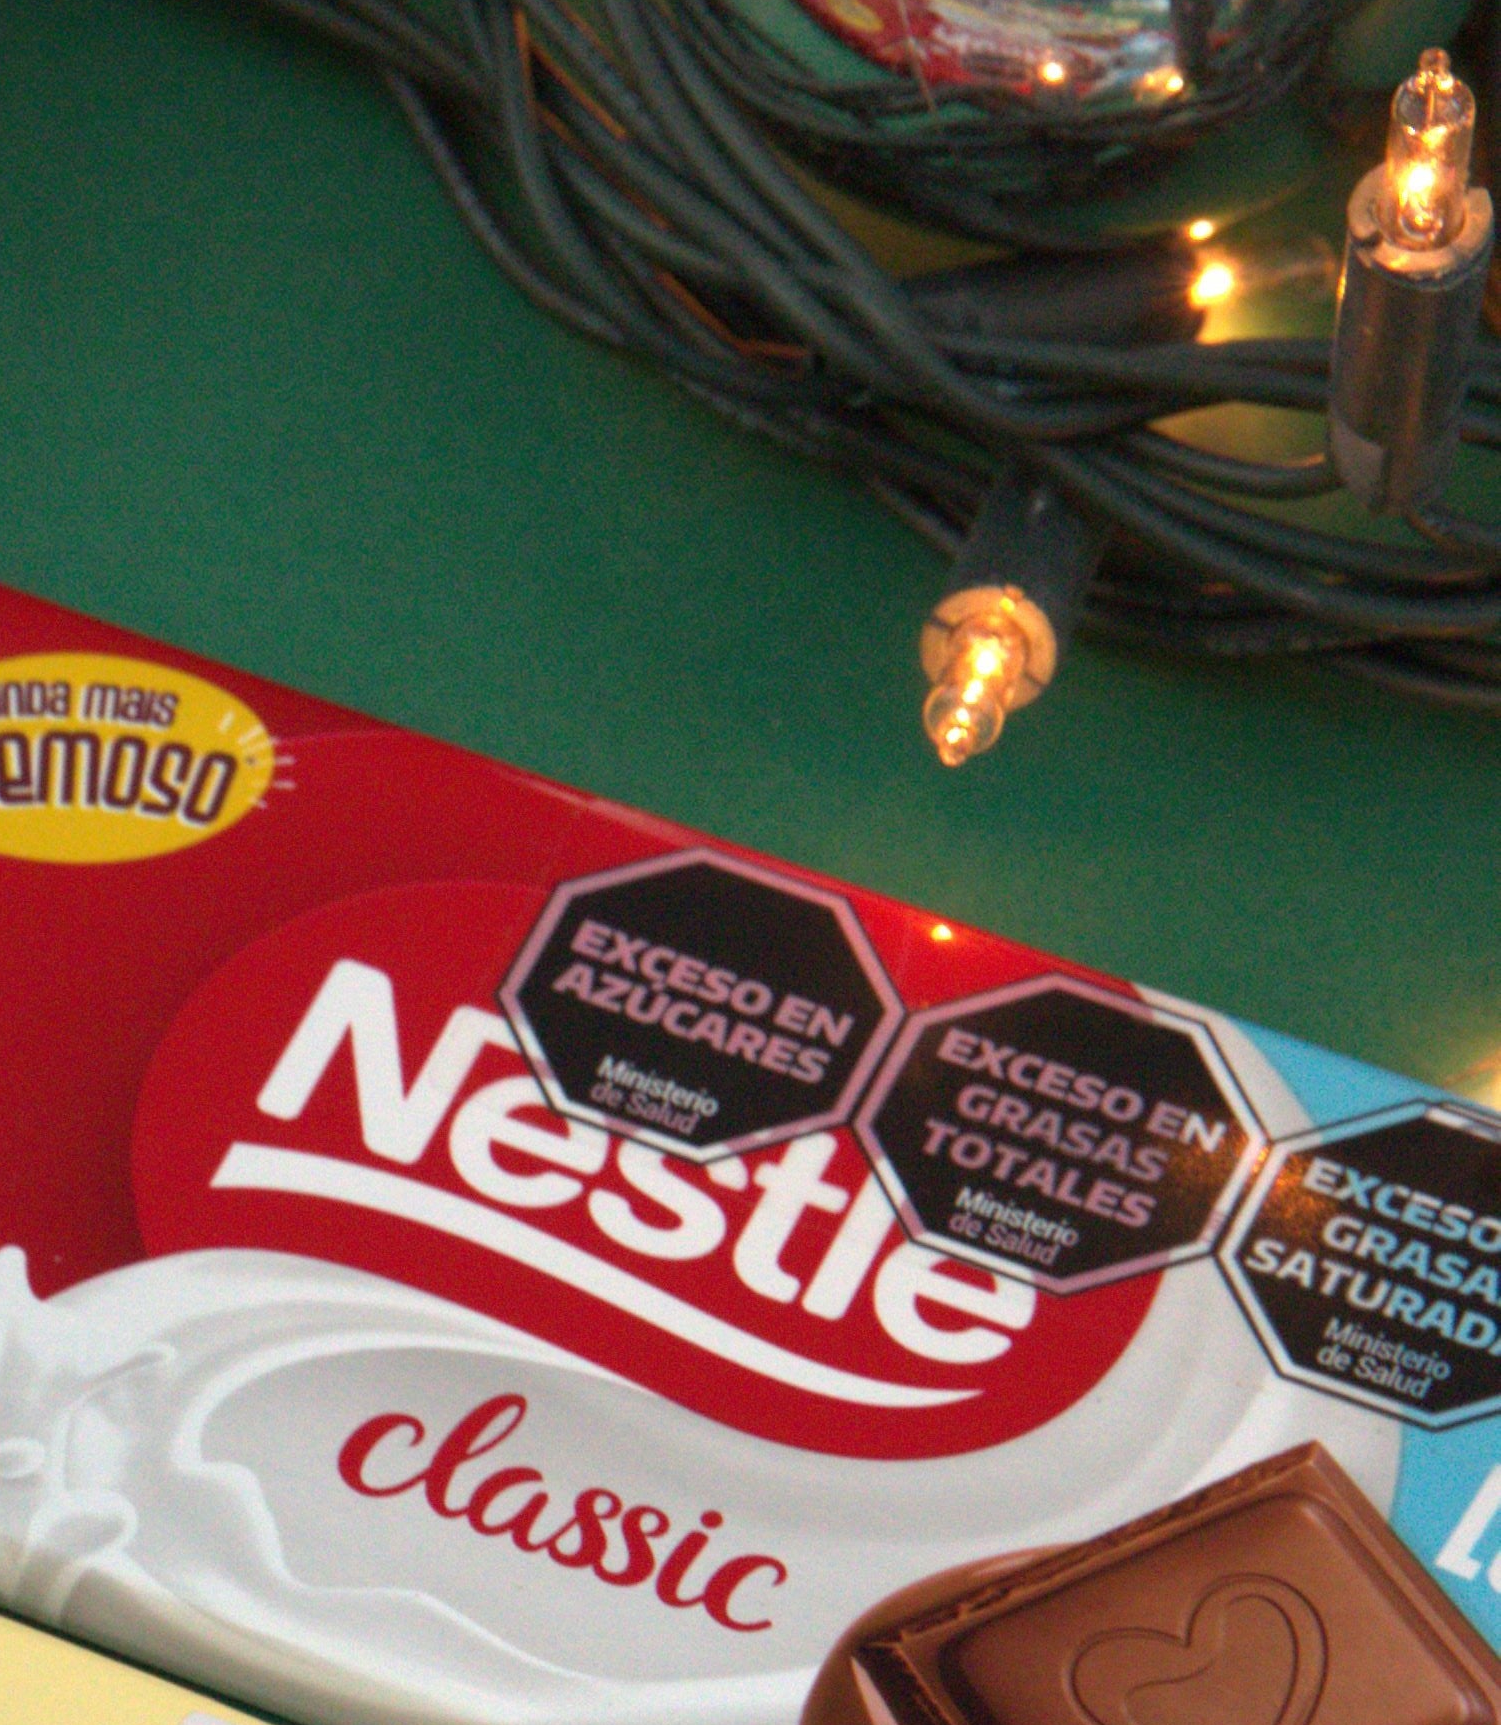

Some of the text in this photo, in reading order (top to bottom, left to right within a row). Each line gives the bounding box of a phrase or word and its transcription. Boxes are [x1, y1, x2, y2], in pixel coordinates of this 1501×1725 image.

[553, 963, 830, 1083] AZÚCARES
[572, 920, 853, 1046] EXCESO EN
[590, 1080, 702, 1135] de Salud
[597, 1055, 719, 1117] Ministerio
[937, 1027, 1226, 1153] EXCESO EN
[957, 1085, 1169, 1182] GRASAS
[924, 1119, 1156, 1227] TOTALES
[956, 1187, 1078, 1246] Ministerio
[1298, 1157, 1501, 1252] EXCESO
[949, 1211, 1062, 1265] de Salud
[1316, 1343, 1432, 1398] de Salud
[1324, 1317, 1451, 1380] Ministerio
[337, 1391, 790, 1634] classic
